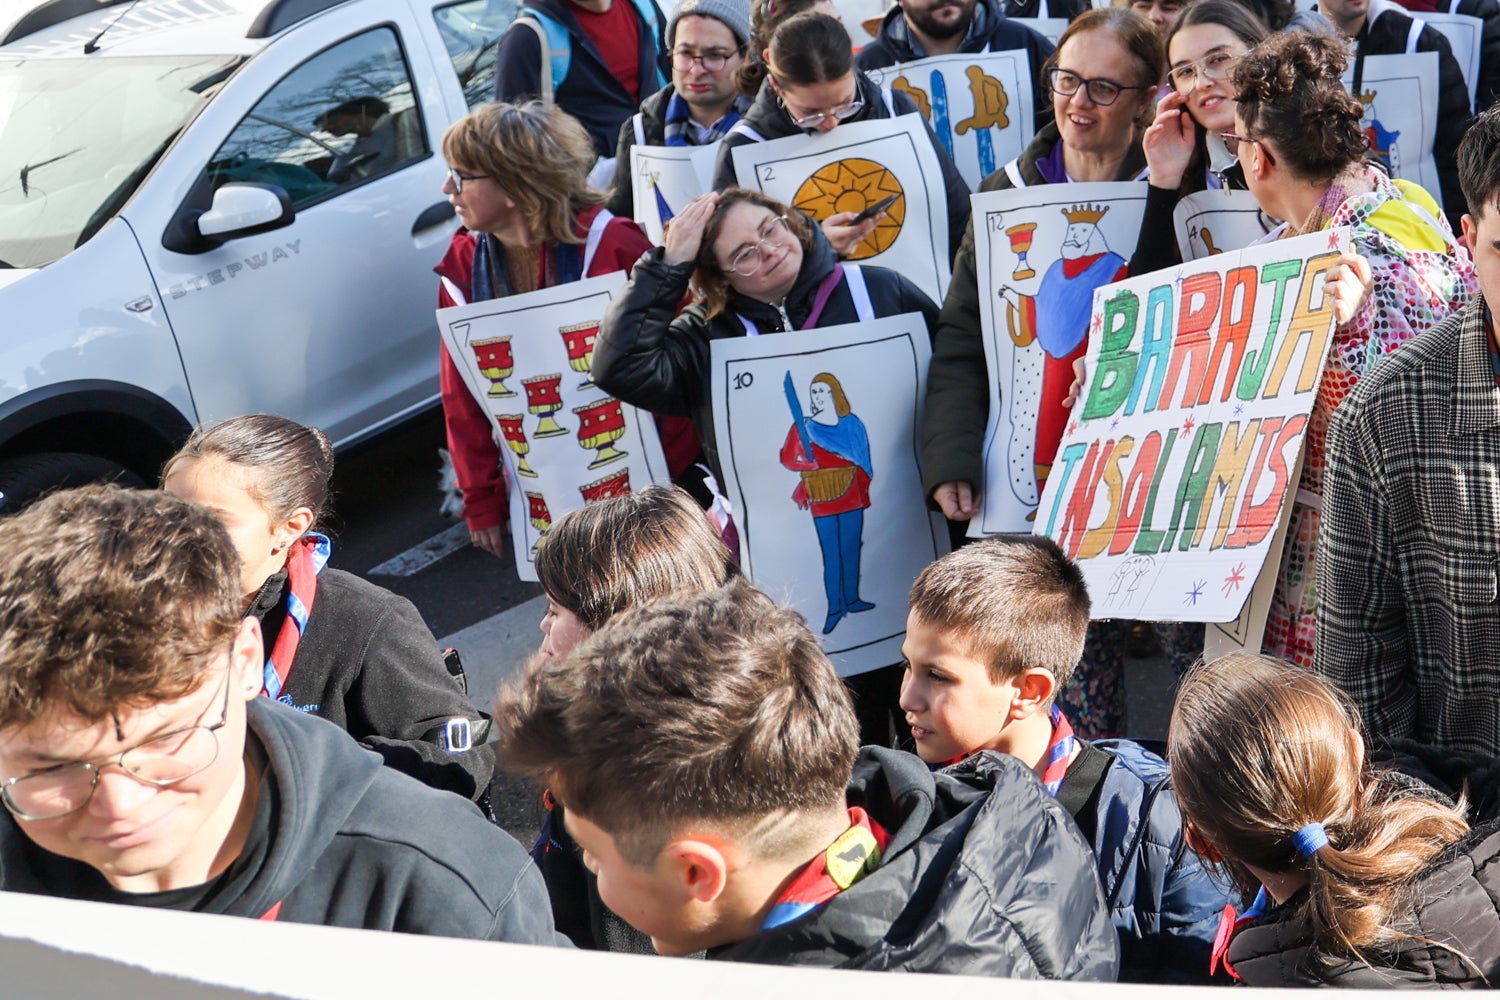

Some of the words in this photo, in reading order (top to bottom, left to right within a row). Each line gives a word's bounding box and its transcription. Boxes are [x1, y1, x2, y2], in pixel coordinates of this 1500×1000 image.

[639, 159, 650, 182] 4
[763, 166, 777, 183] 2
[988, 209, 1007, 232] 12
[1188, 225, 1198, 239] 4
[168, 238, 302, 301] STEPWAY
[454, 322, 471, 348] 7
[1081, 250, 1342, 424] BARAJA
[733, 372, 754, 391] 10
